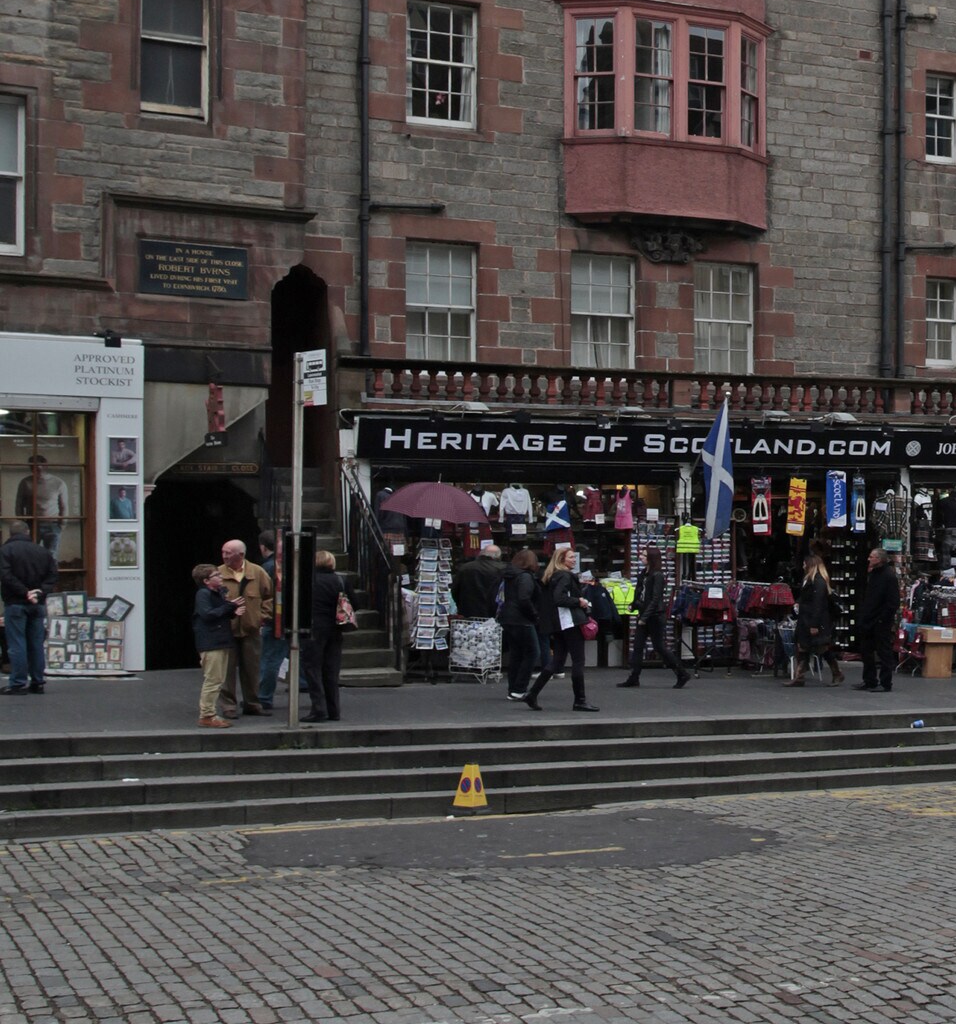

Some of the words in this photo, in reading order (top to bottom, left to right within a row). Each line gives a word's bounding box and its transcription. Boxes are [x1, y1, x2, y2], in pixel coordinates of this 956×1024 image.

[158, 264, 195, 273] ROBERT
[74, 353, 136, 364] APPROVED
[74, 365, 134, 375] PLATINUM
[76, 376, 133, 386] STOCKIST
[384, 428, 568, 452] HERITAGE
[583, 435, 628, 453] OF
[643, 433, 892, 456] SCOLAND.COM
